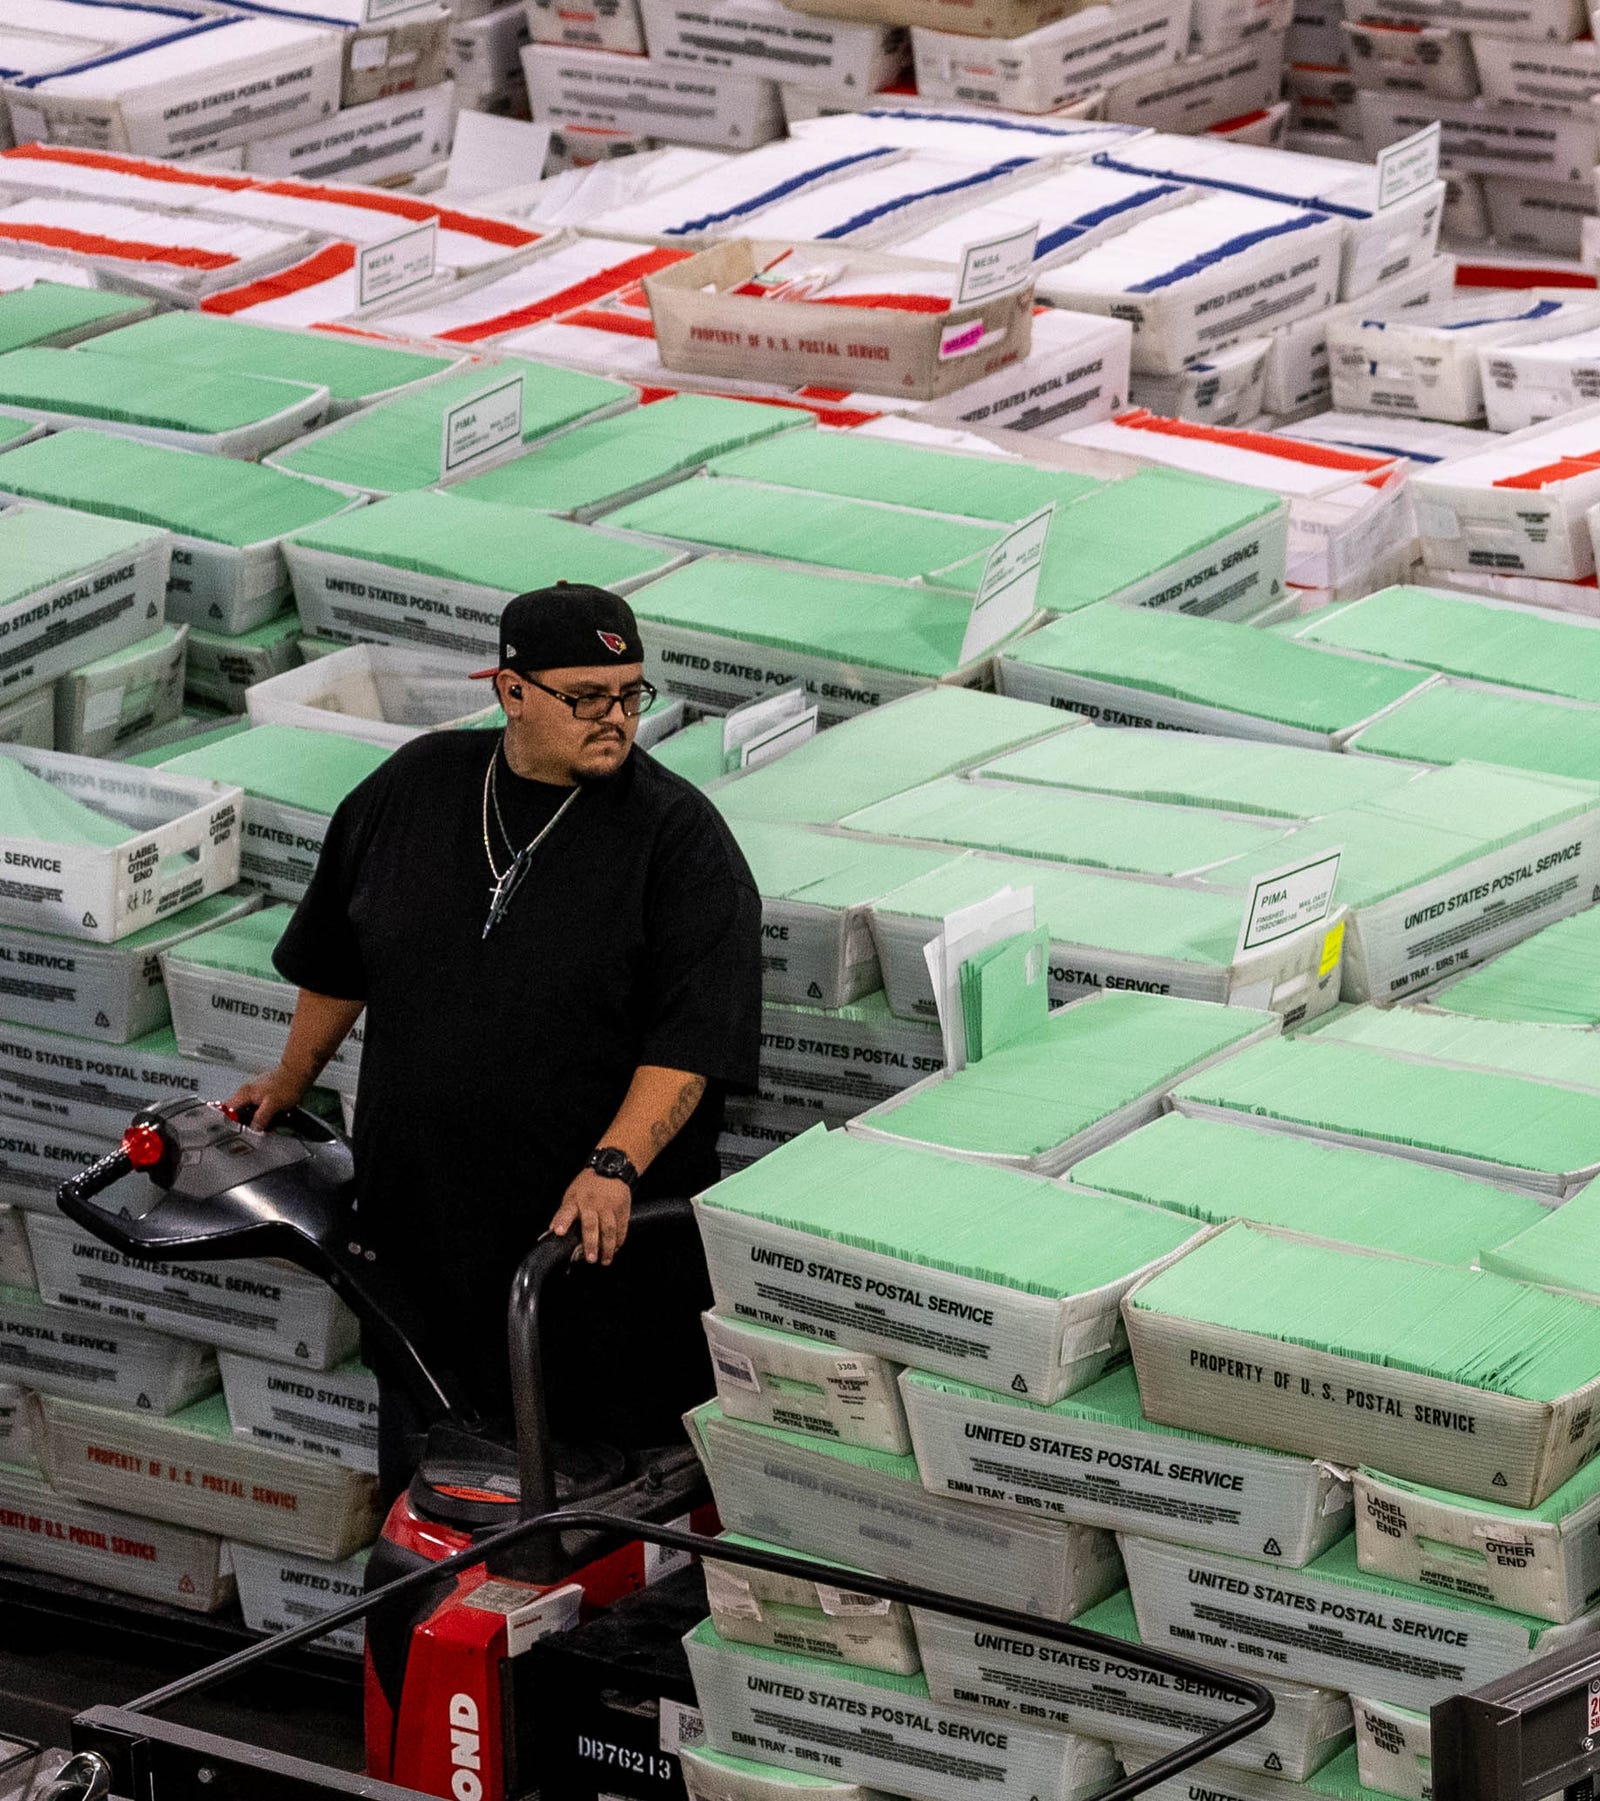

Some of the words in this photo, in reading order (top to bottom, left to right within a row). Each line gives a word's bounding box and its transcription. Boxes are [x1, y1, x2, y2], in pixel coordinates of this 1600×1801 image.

[164, 102, 199, 120] UNITED
[202, 92, 235, 109] STATES
[237, 82, 272, 98] POSTAL
[276, 67, 312, 87] SERVICE
[1195, 296, 1225, 315] UNITED
[1227, 283, 1256, 304] STATES
[1258, 273, 1286, 294] POSTAL
[1290, 256, 1319, 278] SERVICE
[691, 328, 740, 344] PROPERTY
[748, 335, 760, 348] OF
[799, 340, 840, 356] POSTAL
[848, 345, 889, 361] SERVICE
[455, 414, 476, 432] PIMA
[12, 603, 50, 631] STATES
[53, 586, 90, 613] POSTAL
[93, 564, 134, 594] SERVICE
[326, 578, 365, 596] UNITED
[368, 586, 407, 606] STATES
[410, 596, 452, 616] POSTAL
[128, 854, 159, 874] OTHER
[129, 843, 158, 862] LABEL
[133, 868, 152, 883] END
[1405, 902, 1445, 927] UNITED
[1448, 883, 1489, 911] STATES
[1492, 865, 1533, 892] POSTAL
[1536, 842, 1581, 873] SERVICE
[1261, 889, 1287, 907] PIMA
[73, 1244, 119, 1264] UNITED
[172, 1266, 222, 1288] POSTAL
[226, 1276, 281, 1300] SERVICE
[751, 1247, 804, 1273] UNITED
[808, 1263, 862, 1290] STATES
[866, 1279, 923, 1307] POSTAL
[928, 1296, 993, 1325] SERVICE
[735, 1304, 757, 1318] EMM
[758, 1310, 783, 1325] TRAY
[793, 1320, 816, 1334] EIRS
[818, 1327, 836, 1340] 74E
[836, 1362, 858, 1371] 3308
[1191, 1350, 1262, 1382] PROPERTY
[1274, 1371, 1290, 1389] OF
[1347, 1389, 1403, 1417] POSTAL
[1415, 1405, 1475, 1433] SERVICE
[965, 1424, 1025, 1448] UNITED
[1029, 1437, 1092, 1462] STATES
[1097, 1450, 1163, 1476] POSTAL
[1168, 1464, 1243, 1491] SERVICE
[88, 1446, 141, 1471] PROPERTY
[149, 1461, 161, 1476] OF
[202, 1474, 244, 1497] POSTAL
[253, 1487, 297, 1511] SERVICE
[1366, 1492, 1404, 1519] LABEL
[1367, 1505, 1407, 1530] OTHER
[1376, 1519, 1400, 1539] END
[1486, 1542, 1535, 1558] OTHER
[1496, 1554, 1527, 1568] END
[578, 1735, 671, 1780] DB76213
